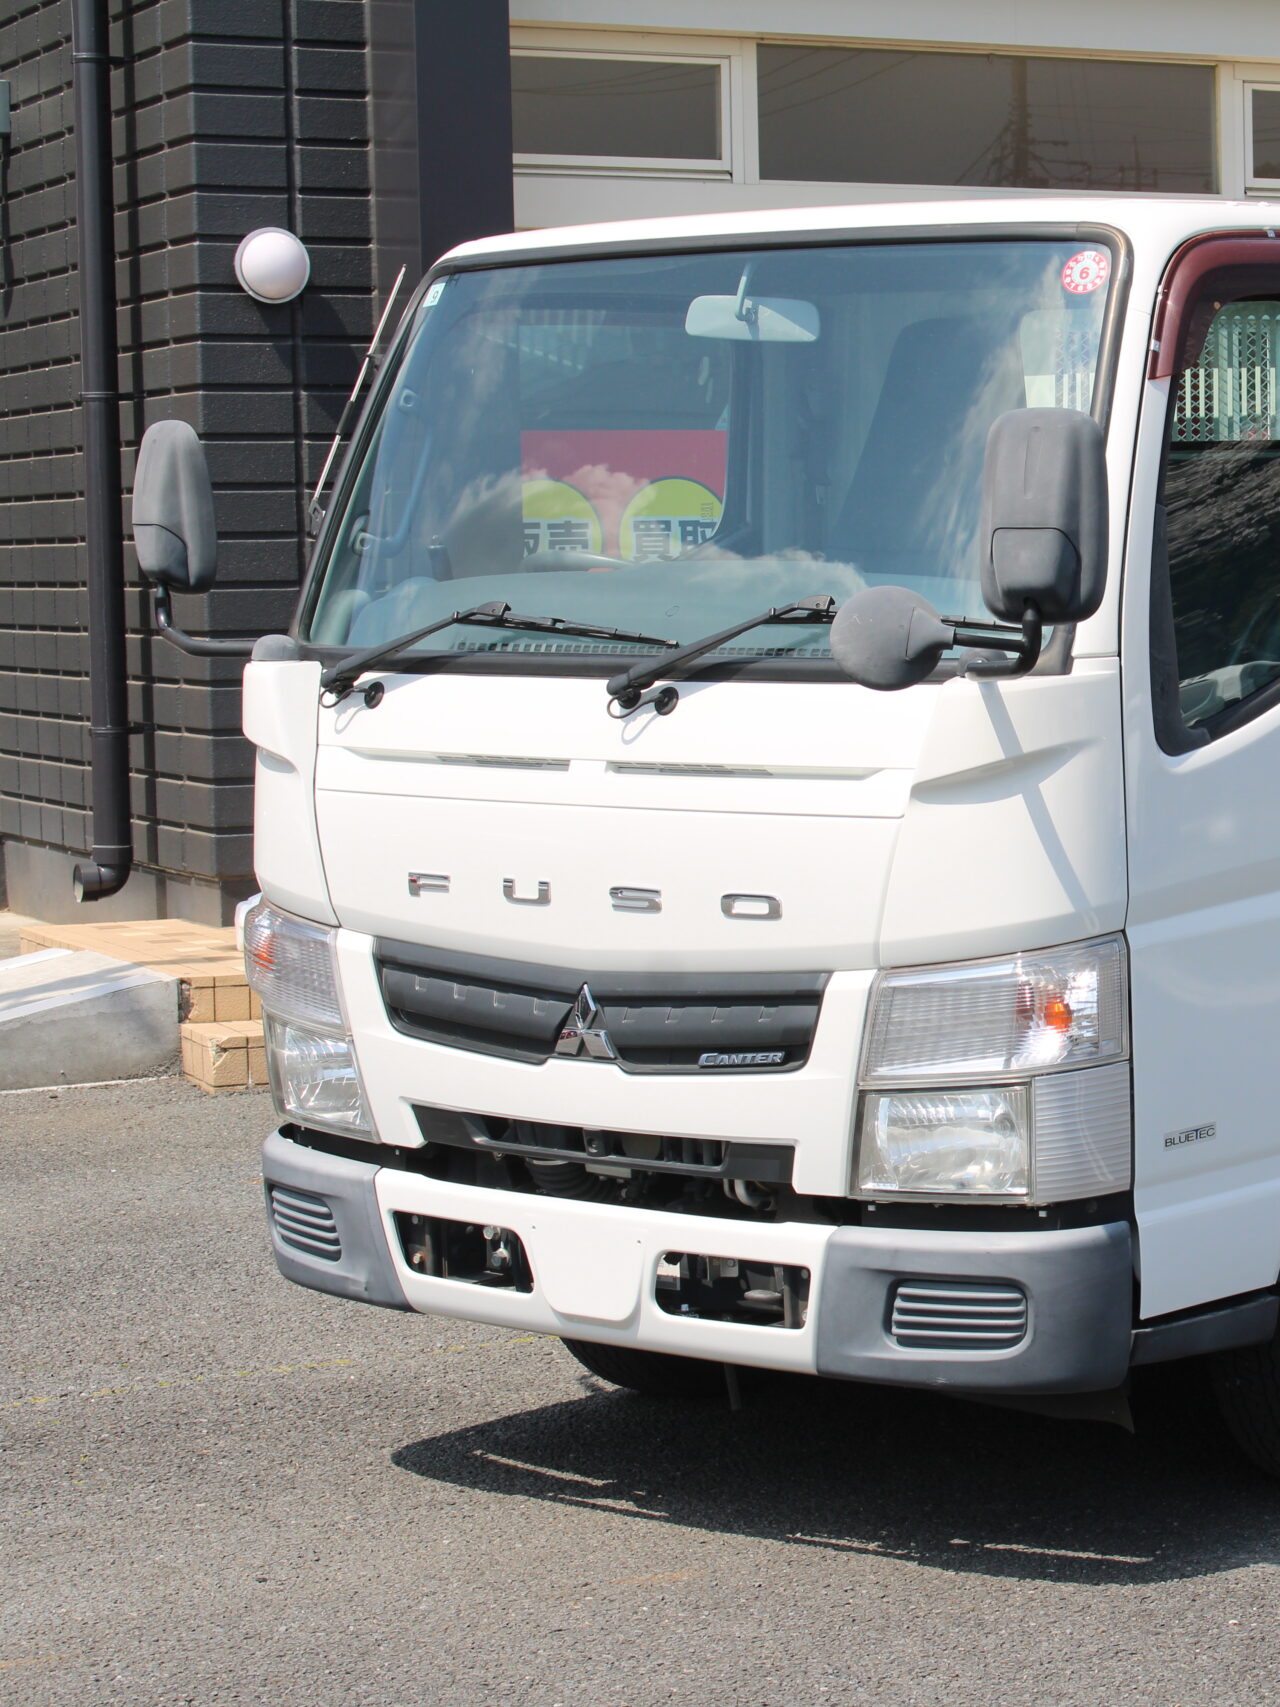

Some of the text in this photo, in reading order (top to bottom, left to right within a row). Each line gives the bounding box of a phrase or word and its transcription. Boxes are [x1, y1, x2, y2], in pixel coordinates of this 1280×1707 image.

[1079, 267, 1090, 279] 6
[408, 871, 782, 920] FUSO
[698, 1052, 785, 1067] CANTER
